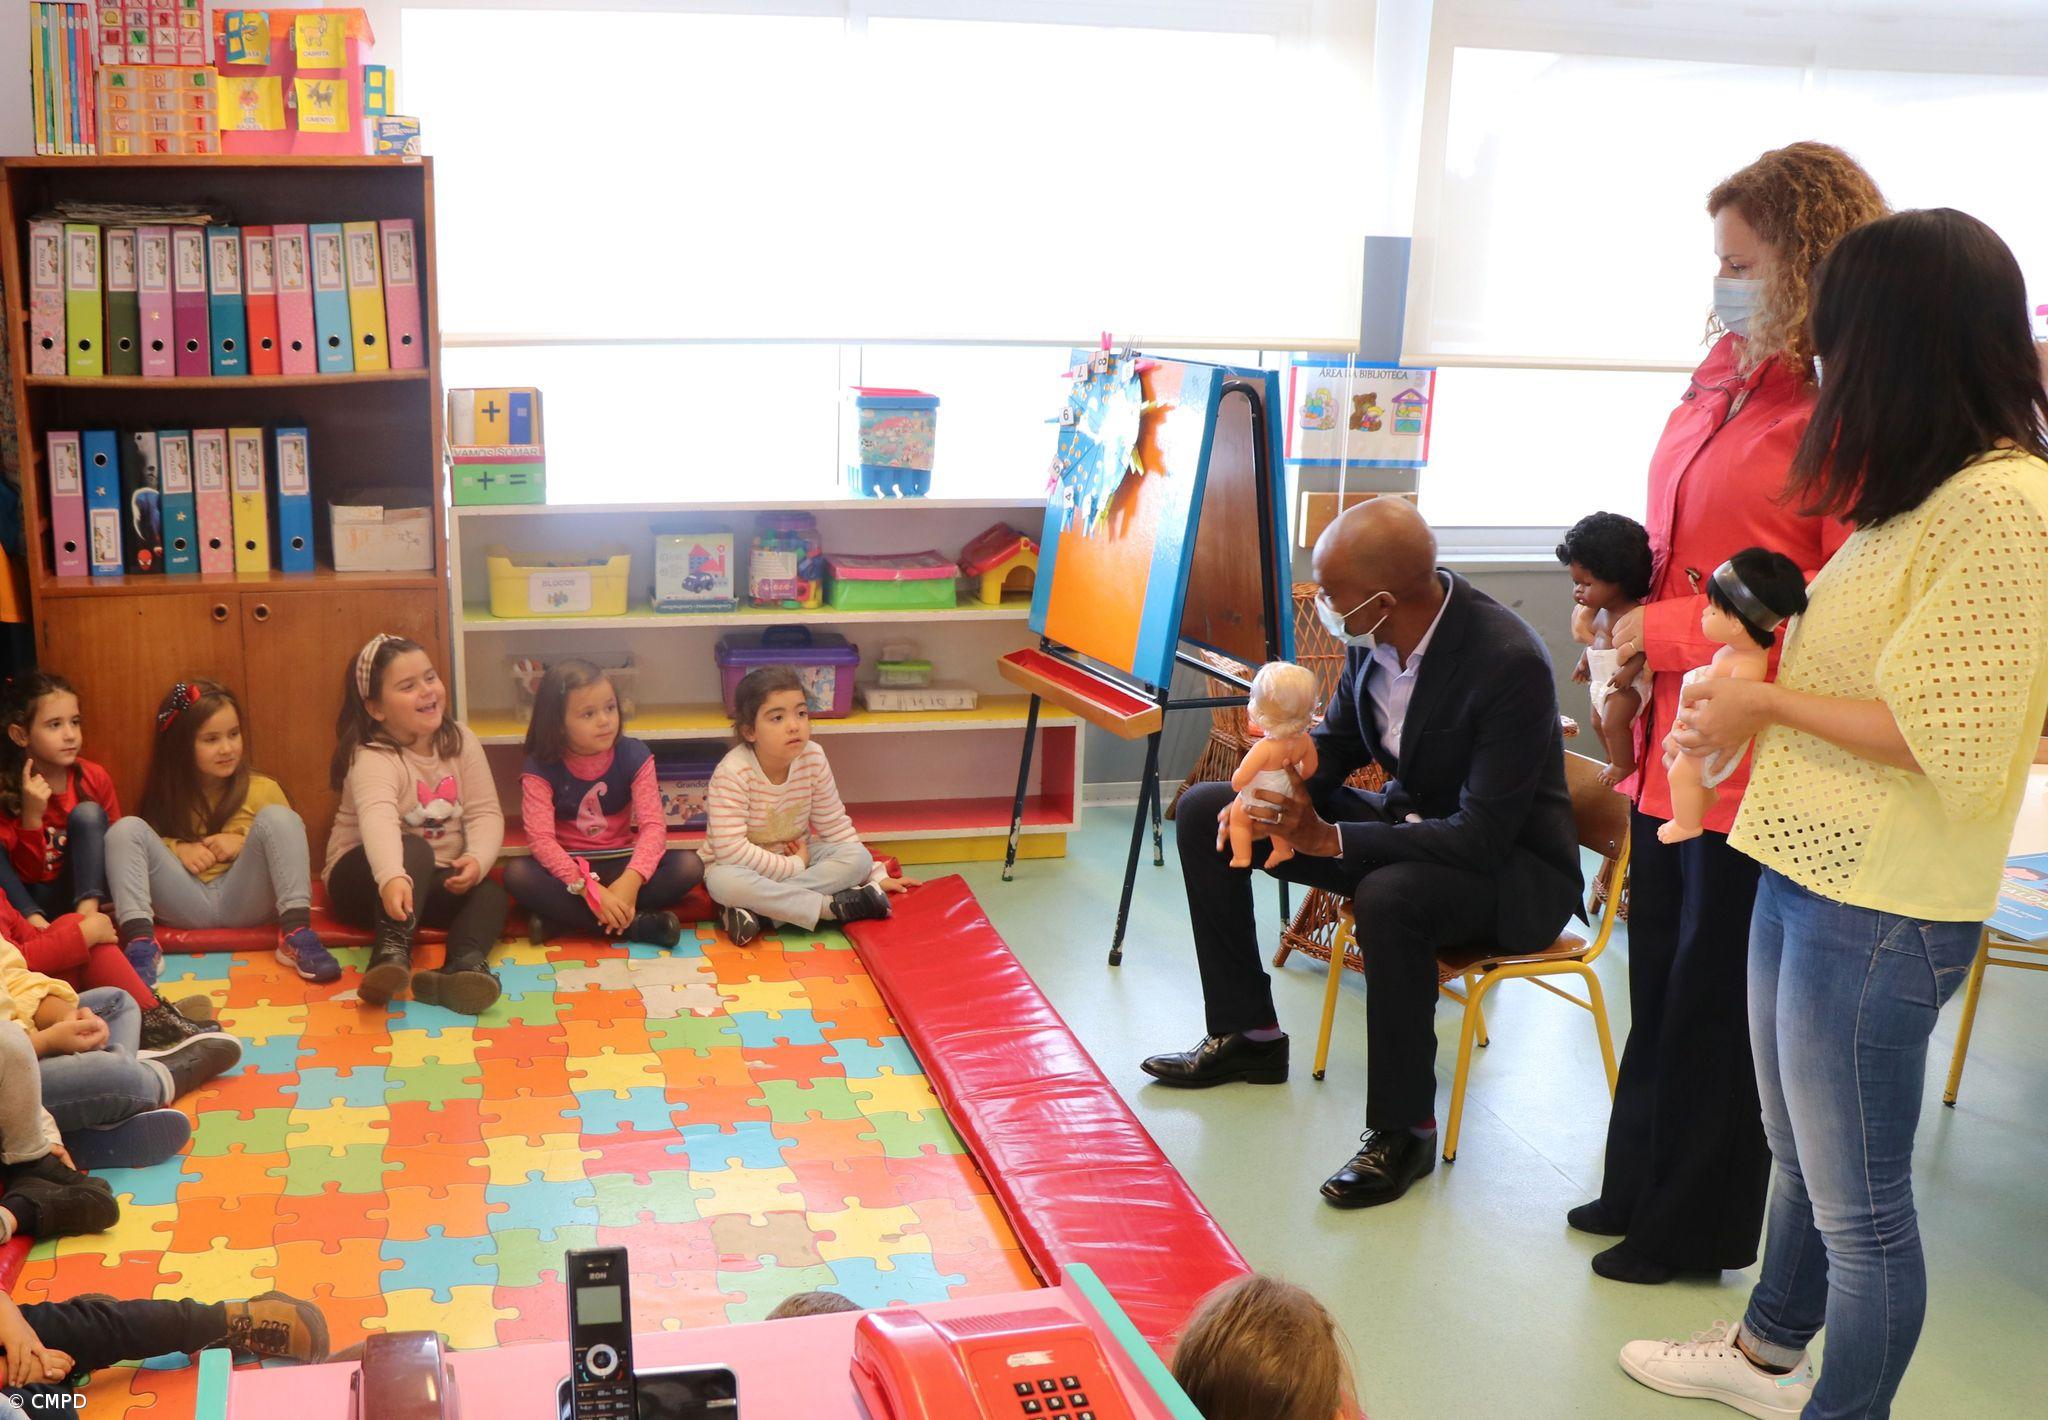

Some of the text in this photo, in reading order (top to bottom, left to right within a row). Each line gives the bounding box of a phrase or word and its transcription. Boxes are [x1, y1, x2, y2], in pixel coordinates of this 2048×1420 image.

[132, 12, 145, 26] R
[132, 30, 146, 44] V
[159, 31, 173, 44] X
[136, 51, 144, 60] Y
[154, 117, 168, 131] H
[155, 138, 168, 153] K
[255, 259, 263, 272] IVO
[1098, 358, 1107, 366] 8
[1077, 365, 1083, 378] 7
[1359, 369, 1408, 380] BIBLIOTECA
[1062, 408, 1069, 421] 6
[498, 447, 537, 456] SOMAR
[1053, 462, 1061, 474] 5
[542, 579, 575, 587] BLOCOS
[1020, 1377, 1075, 1393] 1 2 3
[1028, 1401, 1036, 1409] 4
[1051, 1397, 1060, 1406] 5
